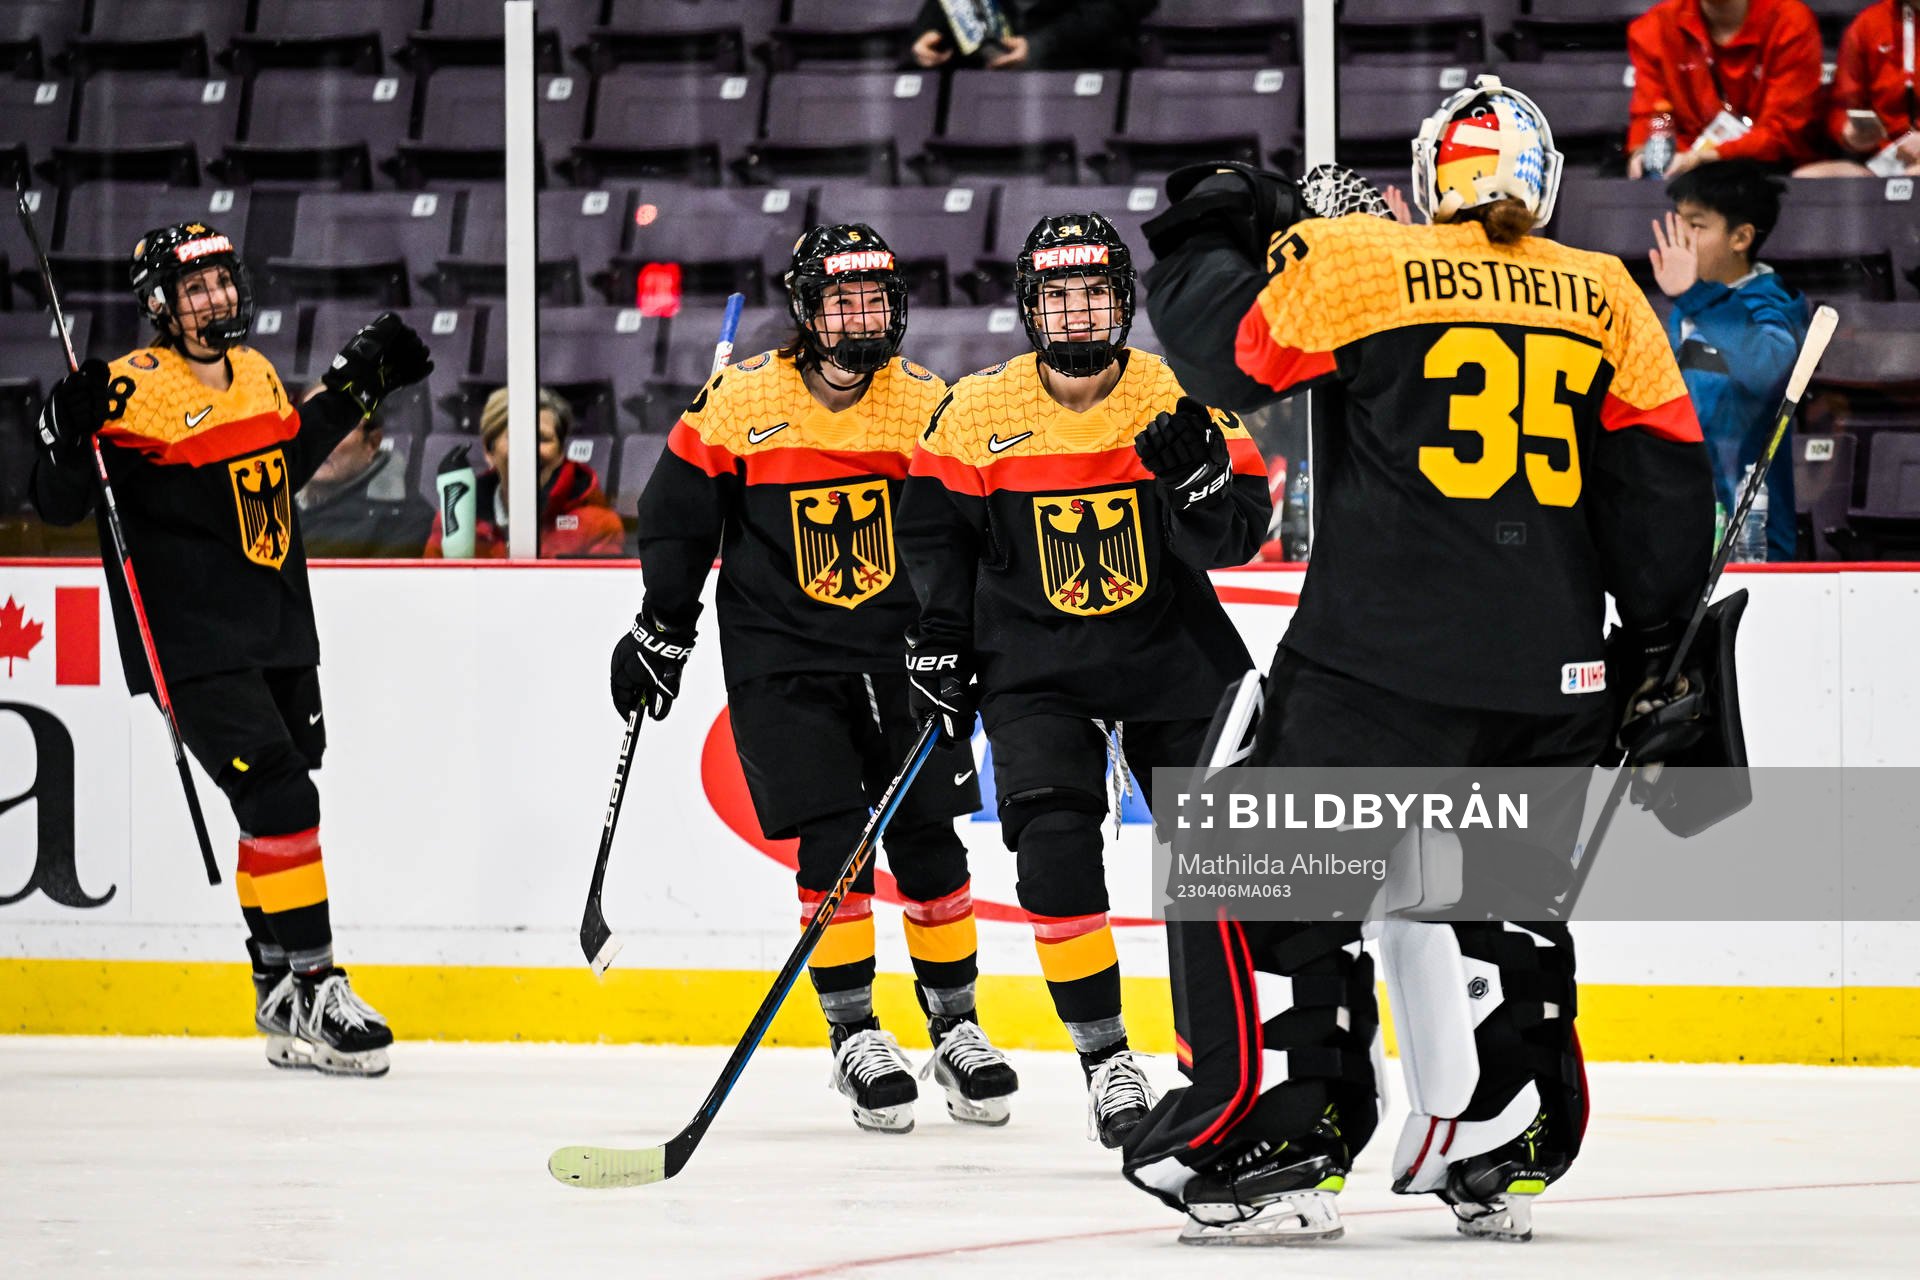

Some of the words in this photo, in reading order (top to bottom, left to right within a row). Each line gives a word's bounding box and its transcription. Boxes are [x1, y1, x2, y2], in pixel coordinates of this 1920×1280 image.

[848, 231, 861, 241] 6
[1058, 224, 1083, 238] 34
[825, 252, 892, 275] PENNY
[1035, 247, 1106, 271] PENNY
[1270, 231, 1309, 277] 5
[1418, 326, 1604, 508] 35
[905, 654, 958, 671] UER
[816, 840, 869, 931] SYNC
